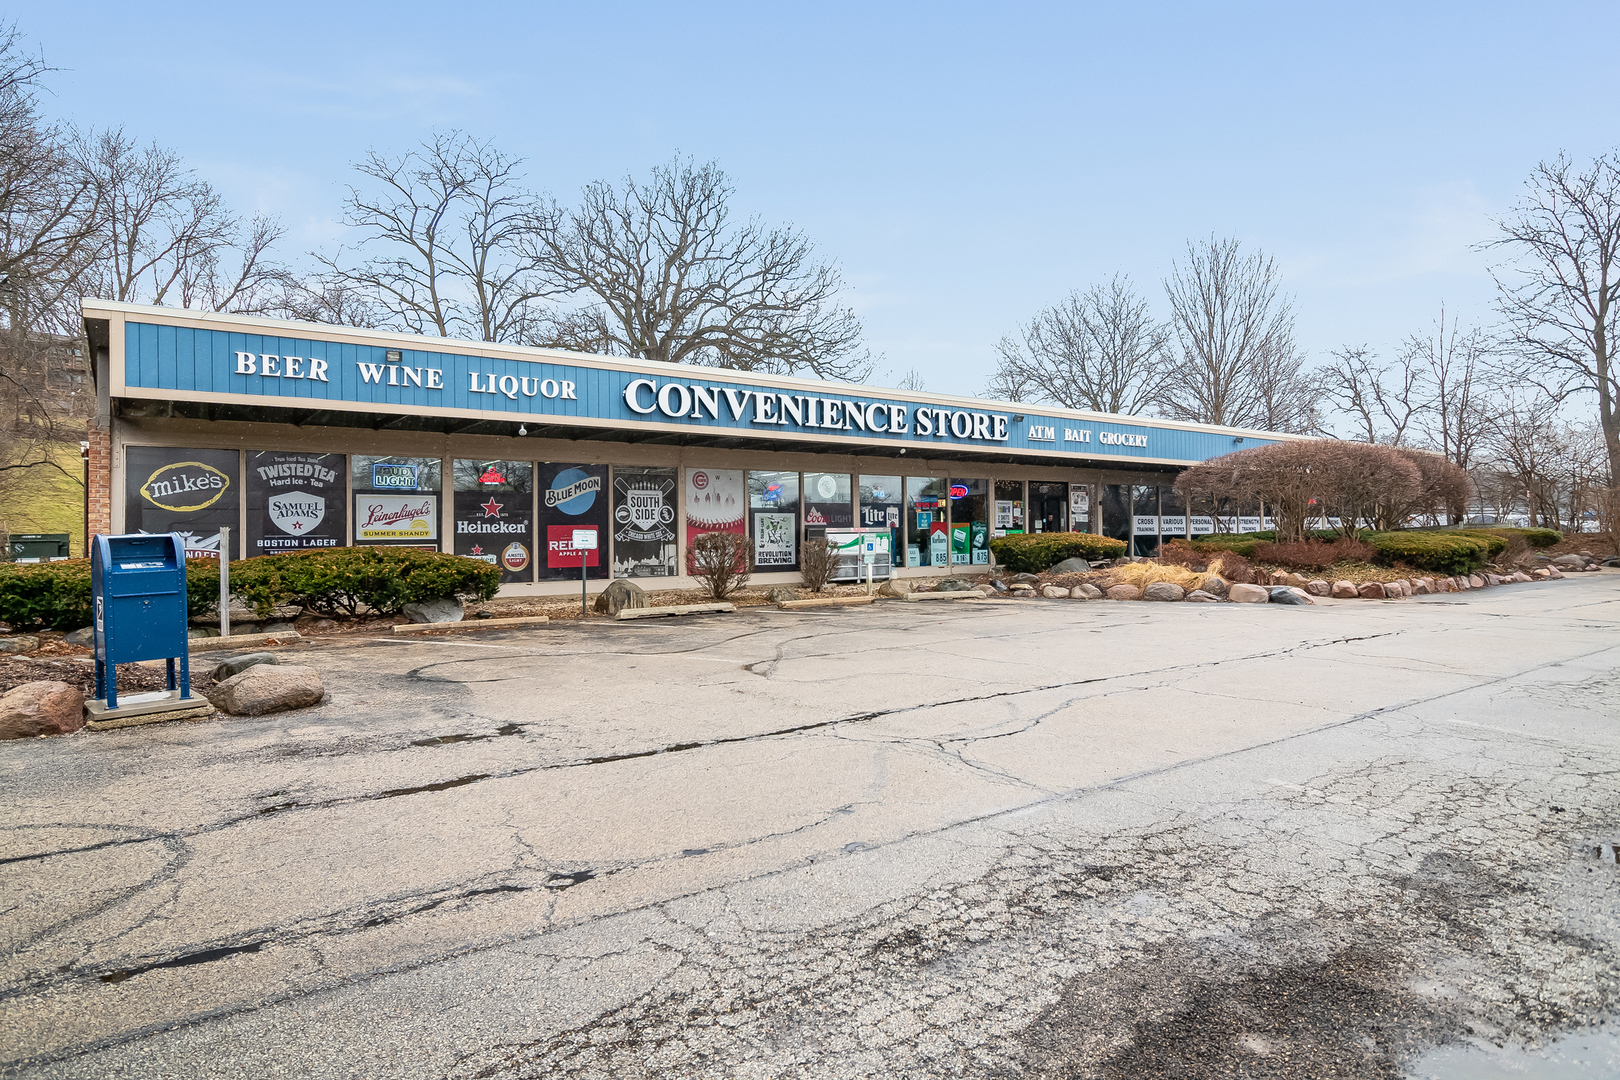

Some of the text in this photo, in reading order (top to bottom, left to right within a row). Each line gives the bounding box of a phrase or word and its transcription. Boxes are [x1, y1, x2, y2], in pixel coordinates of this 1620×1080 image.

[234, 351, 577, 400] BEER WINE LIQUOR
[623, 379, 1009, 441] CONVENIENCE STORE
[1028, 425, 1148, 448] ATM BAIT GROCERY
[257, 464, 335, 483] TWISTED TEA
[381, 466, 410, 477] BUD
[151, 473, 222, 498] mike's
[270, 478, 290, 487] Hard
[310, 479, 324, 487] Tea
[376, 476, 415, 486] LIGHT
[546, 478, 599, 505] BLUE MOON
[950, 487, 966, 497] OPEN
[272, 501, 322, 511] SAMUEL
[631, 496, 660, 508] SOUTH
[276, 510, 319, 520] ADAMS
[361, 501, 431, 529] Leinenkugel's
[635, 508, 656, 520] SIDE
[805, 511, 852, 523] Coors LIGHT
[865, 506, 884, 525] Lite
[457, 521, 526, 533] Heineken
